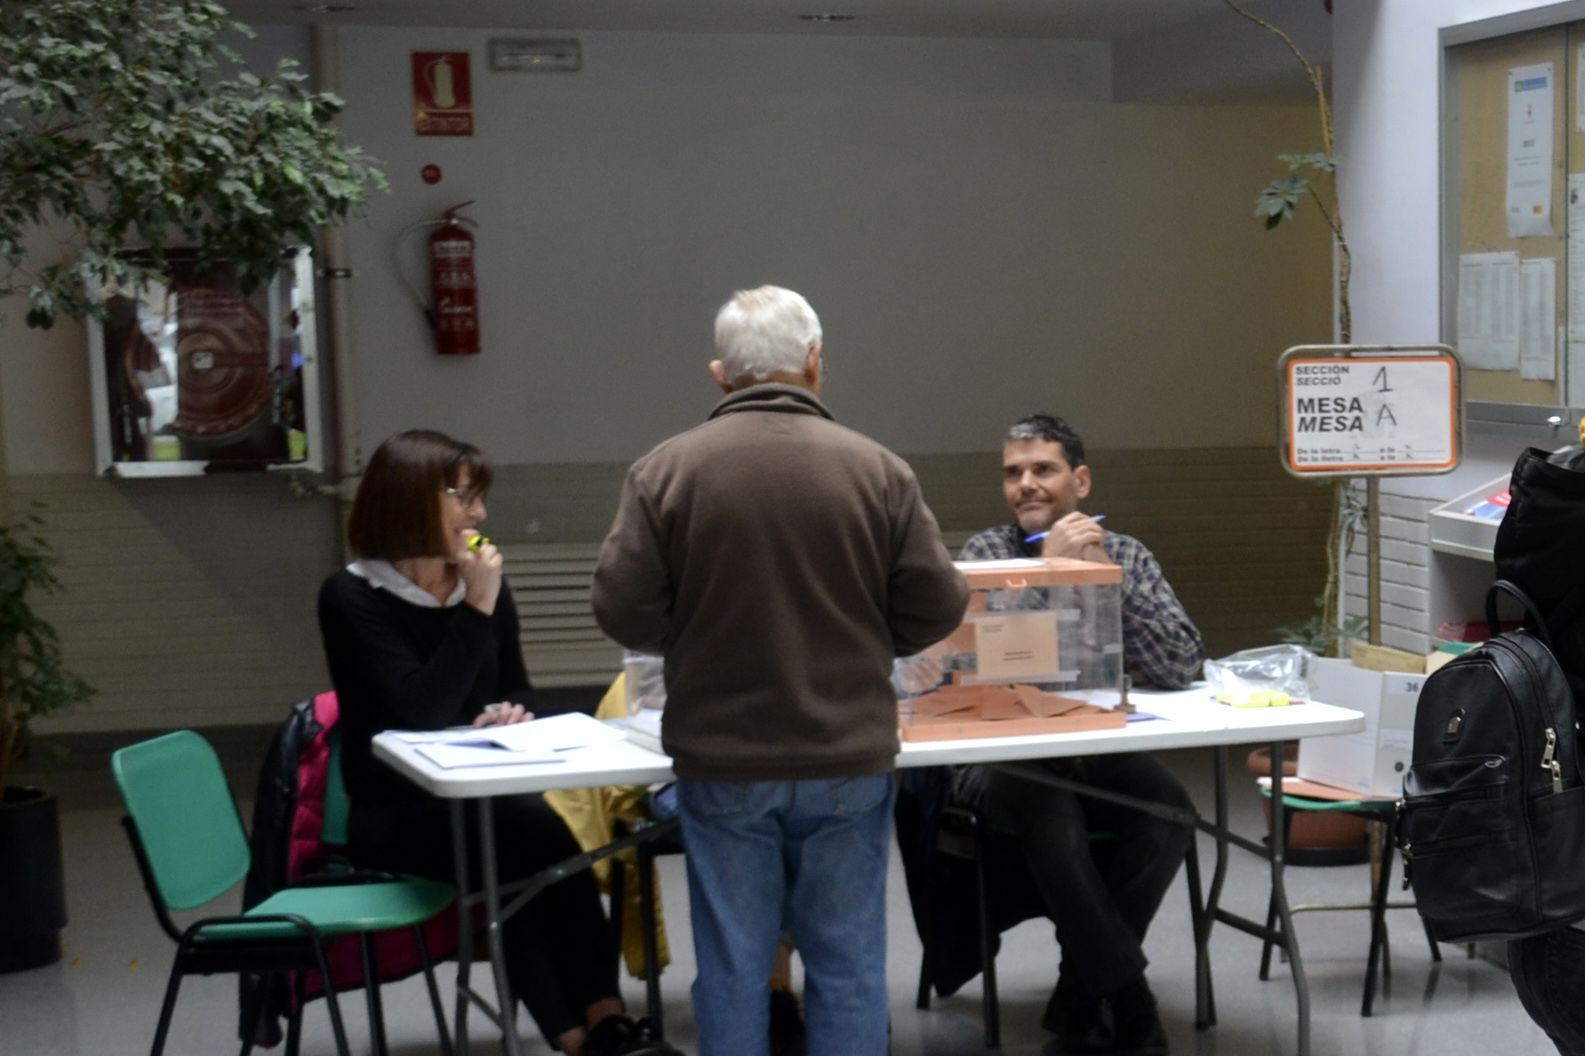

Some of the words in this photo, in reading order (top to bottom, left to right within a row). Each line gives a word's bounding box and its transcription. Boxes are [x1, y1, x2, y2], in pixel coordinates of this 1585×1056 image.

[1296, 365, 1350, 375] SECCIÓN
[1297, 397, 1363, 414] MESA
[1375, 403, 1398, 427] A
[1298, 416, 1364, 433] MESA
[1405, 682, 1419, 692] 36
